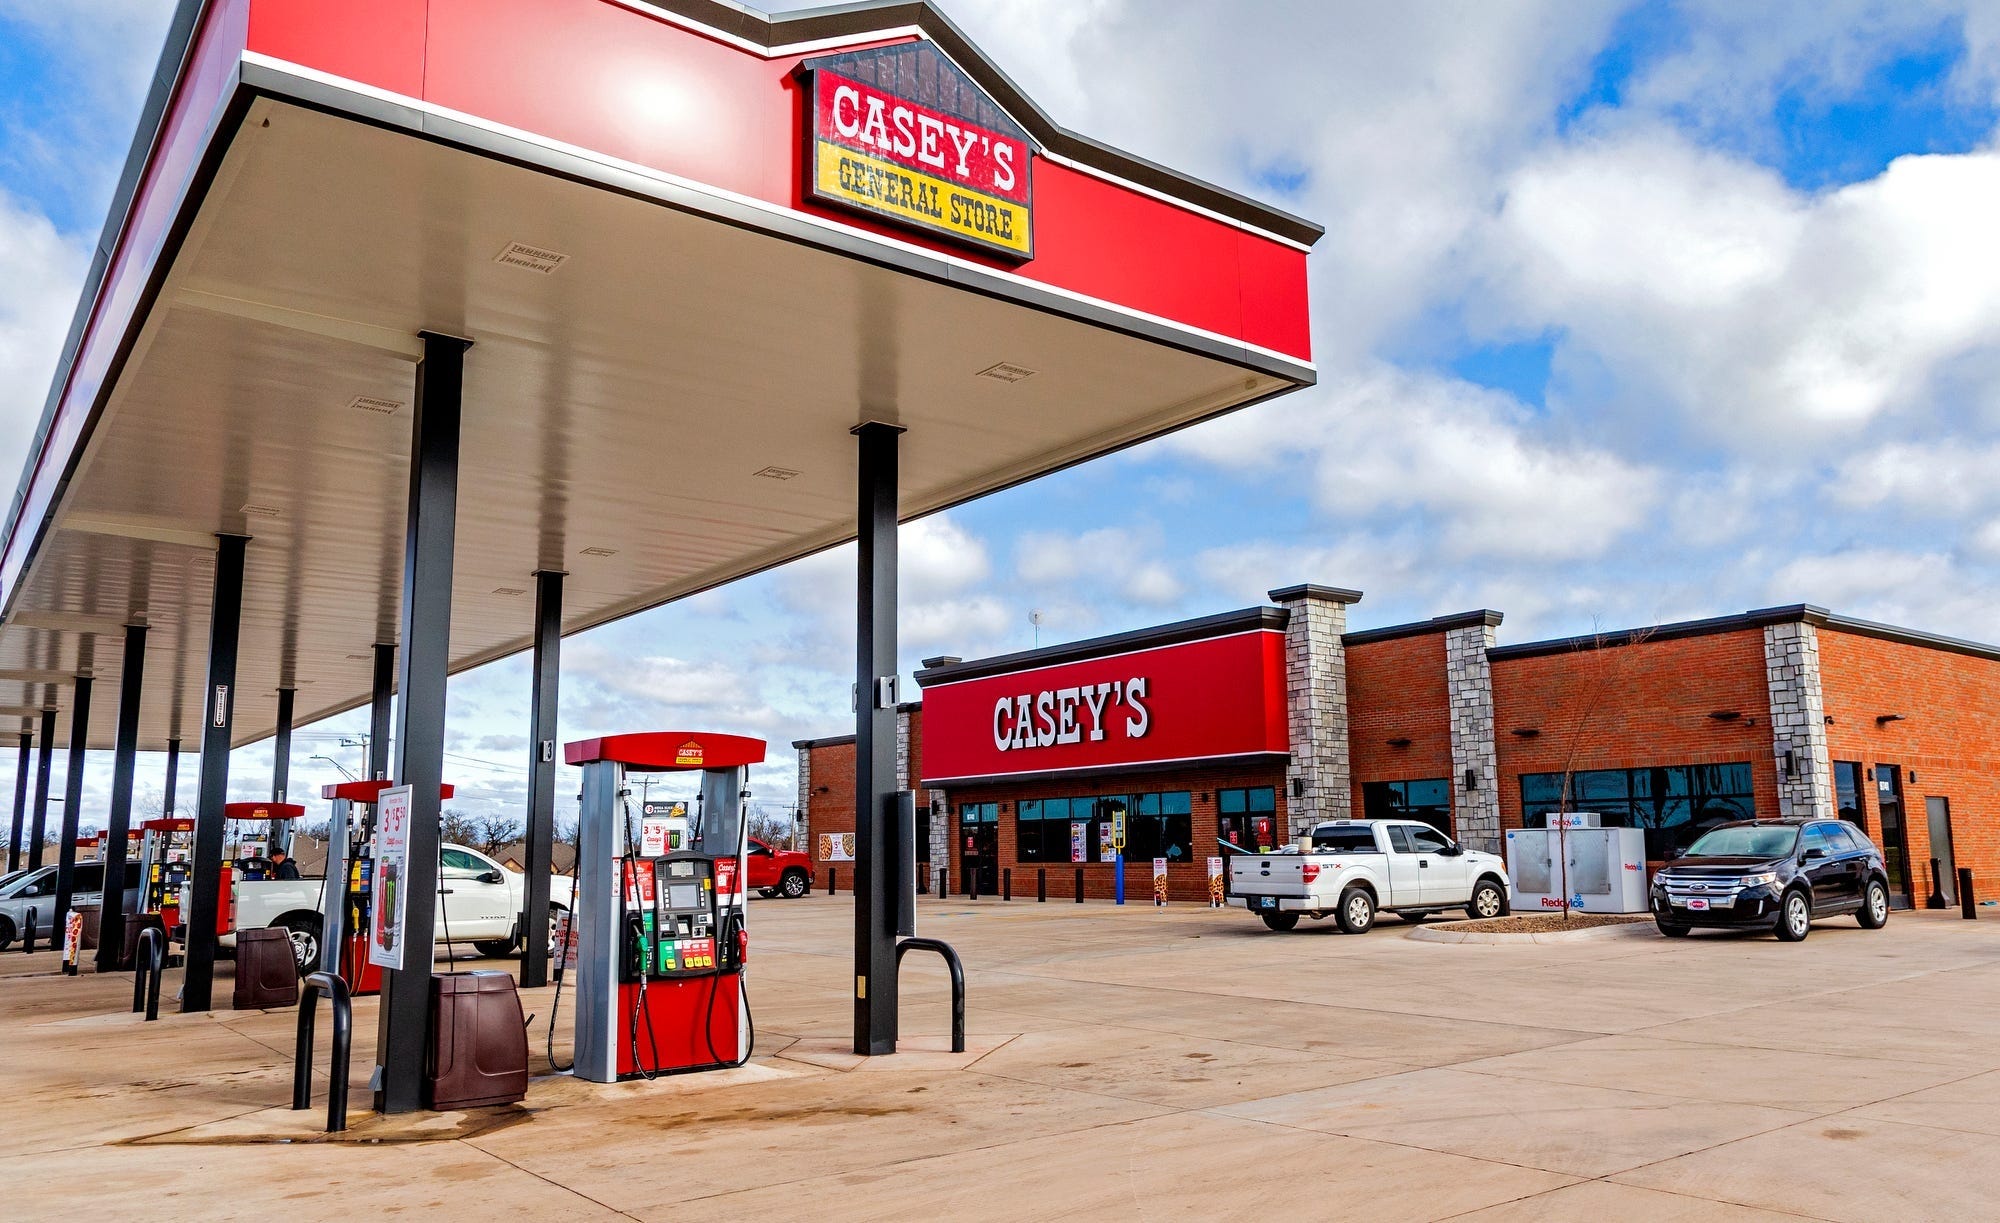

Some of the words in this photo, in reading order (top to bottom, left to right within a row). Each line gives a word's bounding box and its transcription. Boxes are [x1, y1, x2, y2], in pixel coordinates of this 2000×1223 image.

[833, 85, 1015, 191] CASEY'S
[839, 157, 943, 219] GENERAL
[950, 192, 1013, 241] STORE
[888, 678, 896, 704] 1
[993, 677, 1148, 752] CASEY'S
[547, 741, 553, 759] 3
[678, 749, 703, 757] CASEY'S
